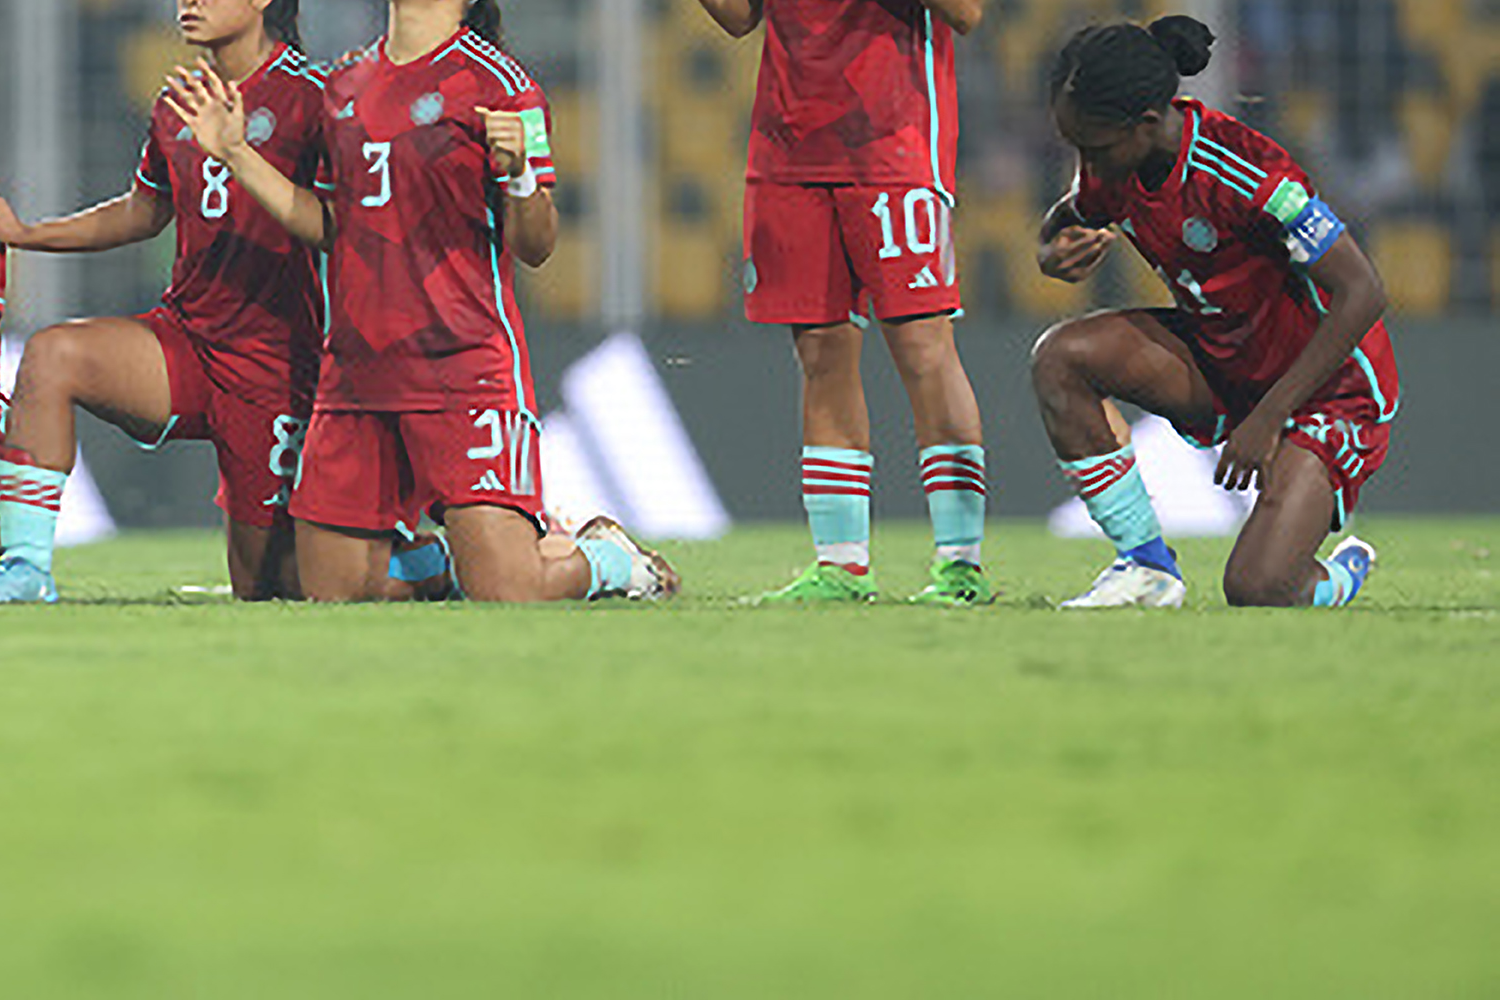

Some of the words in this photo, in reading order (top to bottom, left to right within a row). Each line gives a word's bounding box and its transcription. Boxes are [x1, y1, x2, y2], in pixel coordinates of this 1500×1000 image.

[201, 156, 231, 218] 8
[361, 142, 392, 207] 3
[871, 187, 936, 258] 10
